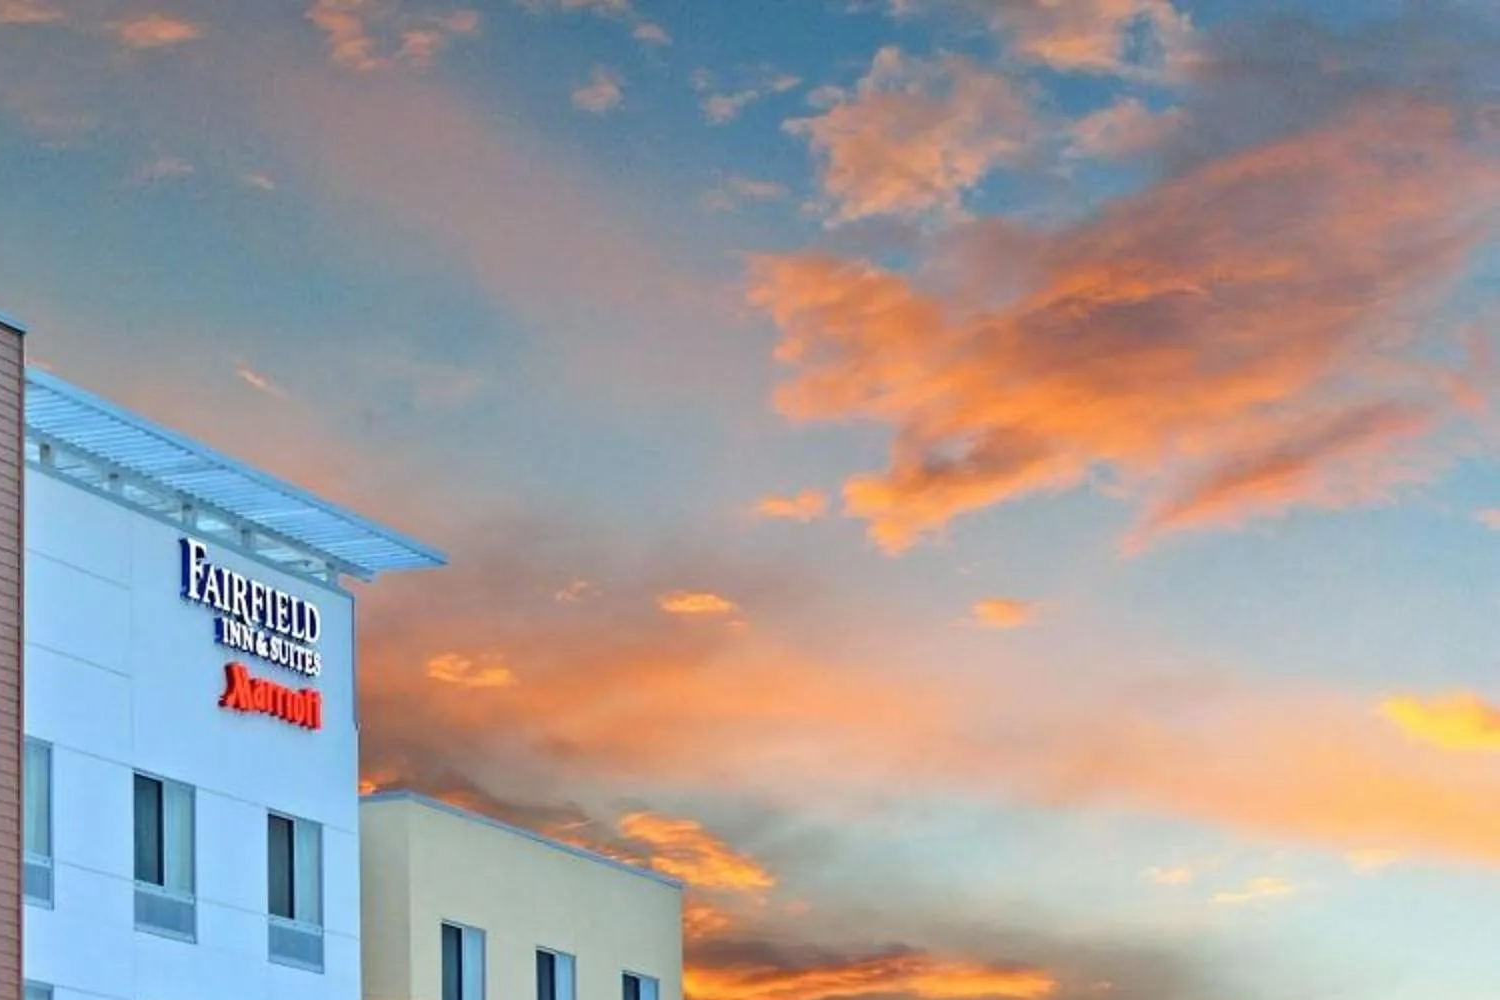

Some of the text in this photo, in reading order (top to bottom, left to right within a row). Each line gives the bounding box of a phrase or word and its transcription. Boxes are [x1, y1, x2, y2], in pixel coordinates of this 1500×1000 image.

[182, 537, 321, 644] FAIRFIELD
[219, 617, 255, 653] INN
[270, 635, 321, 677] SUITES
